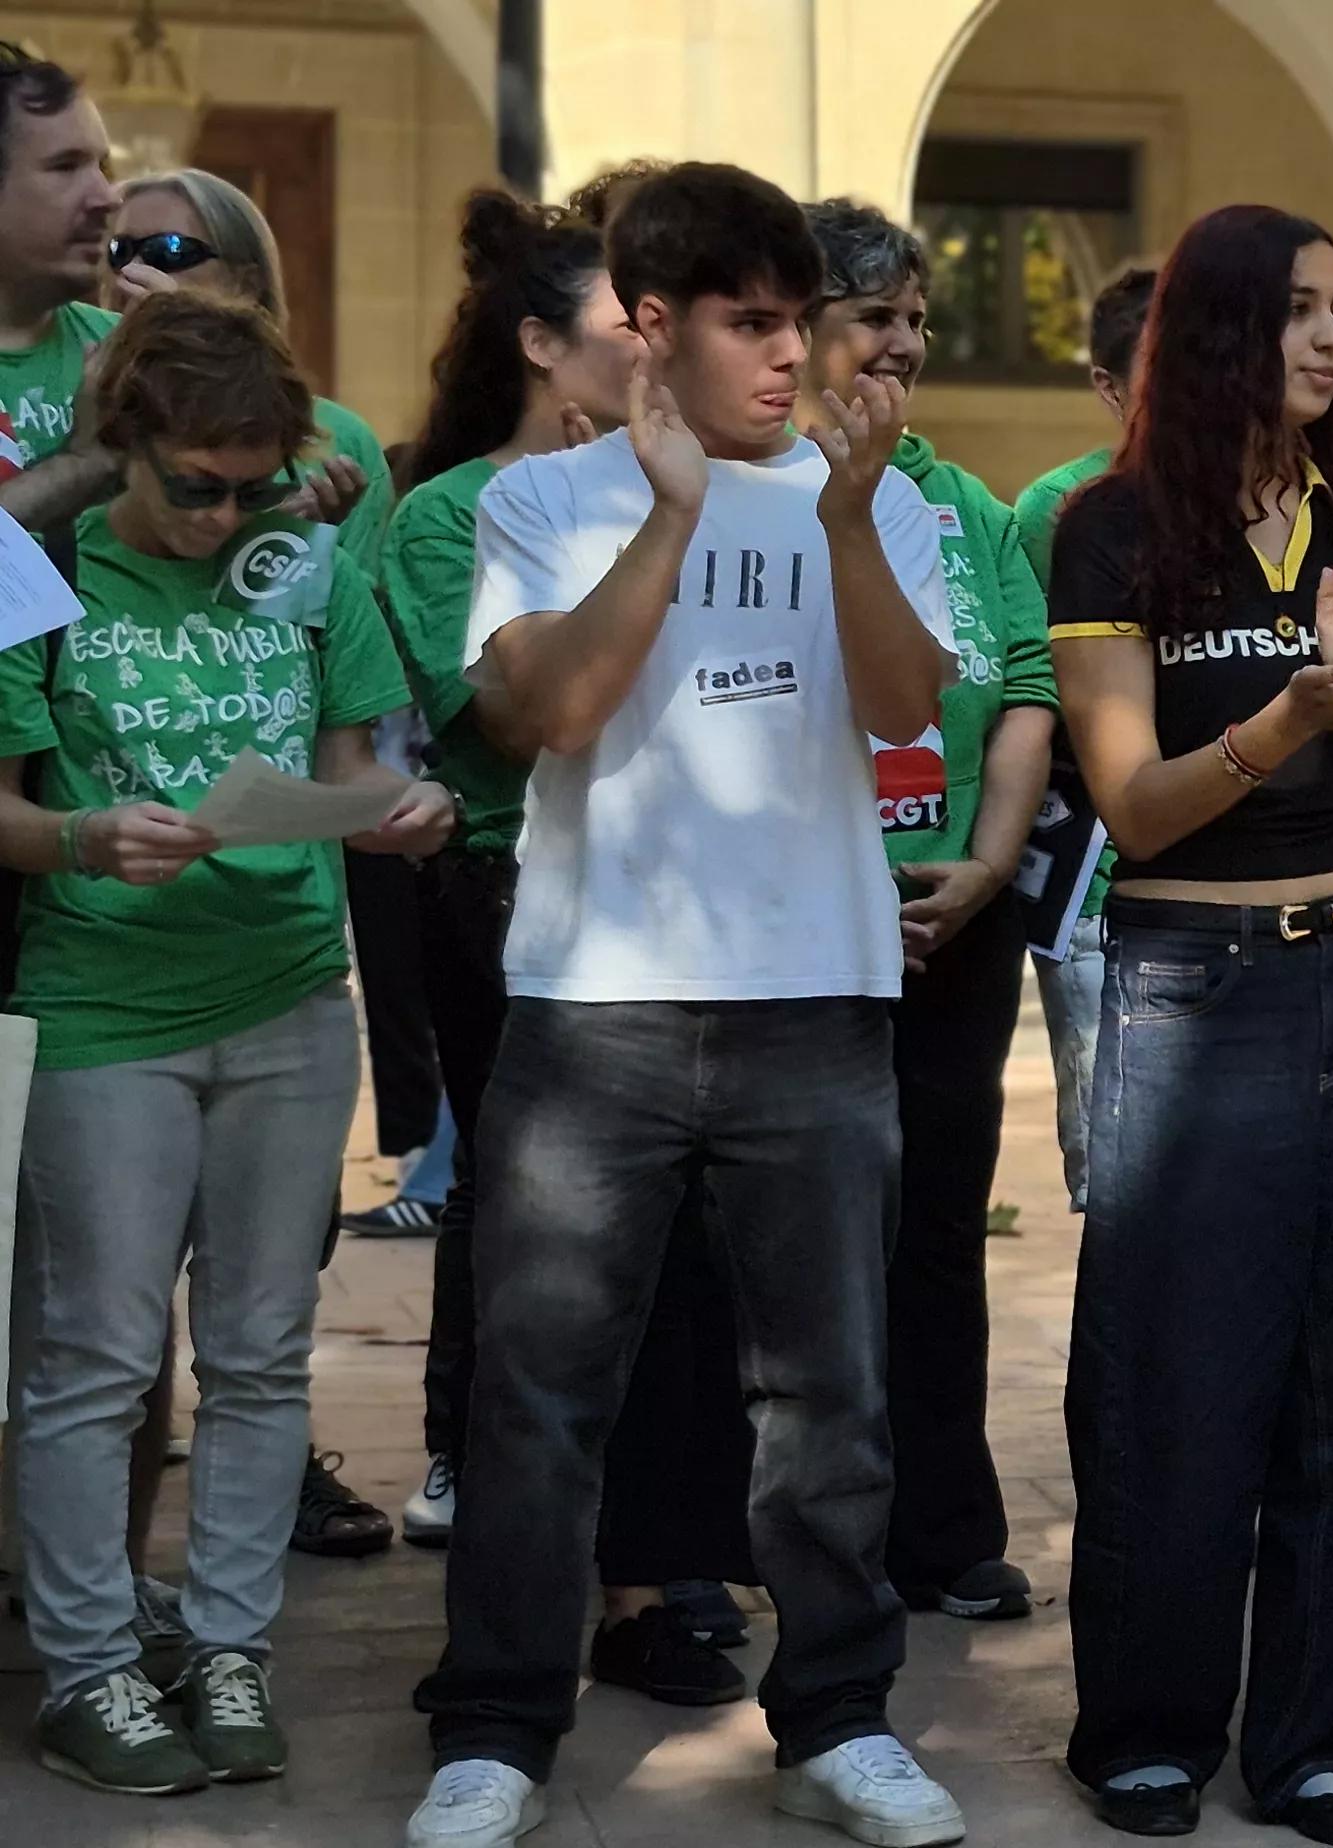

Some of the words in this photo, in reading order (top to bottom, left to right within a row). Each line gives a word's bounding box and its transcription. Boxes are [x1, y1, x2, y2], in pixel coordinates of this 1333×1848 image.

[249, 549, 317, 583] CSIF
[671, 549, 803, 611] IRI
[694, 660, 796, 692] fadea
[112, 696, 171, 734] DE
[878, 793, 942, 829] CGT
